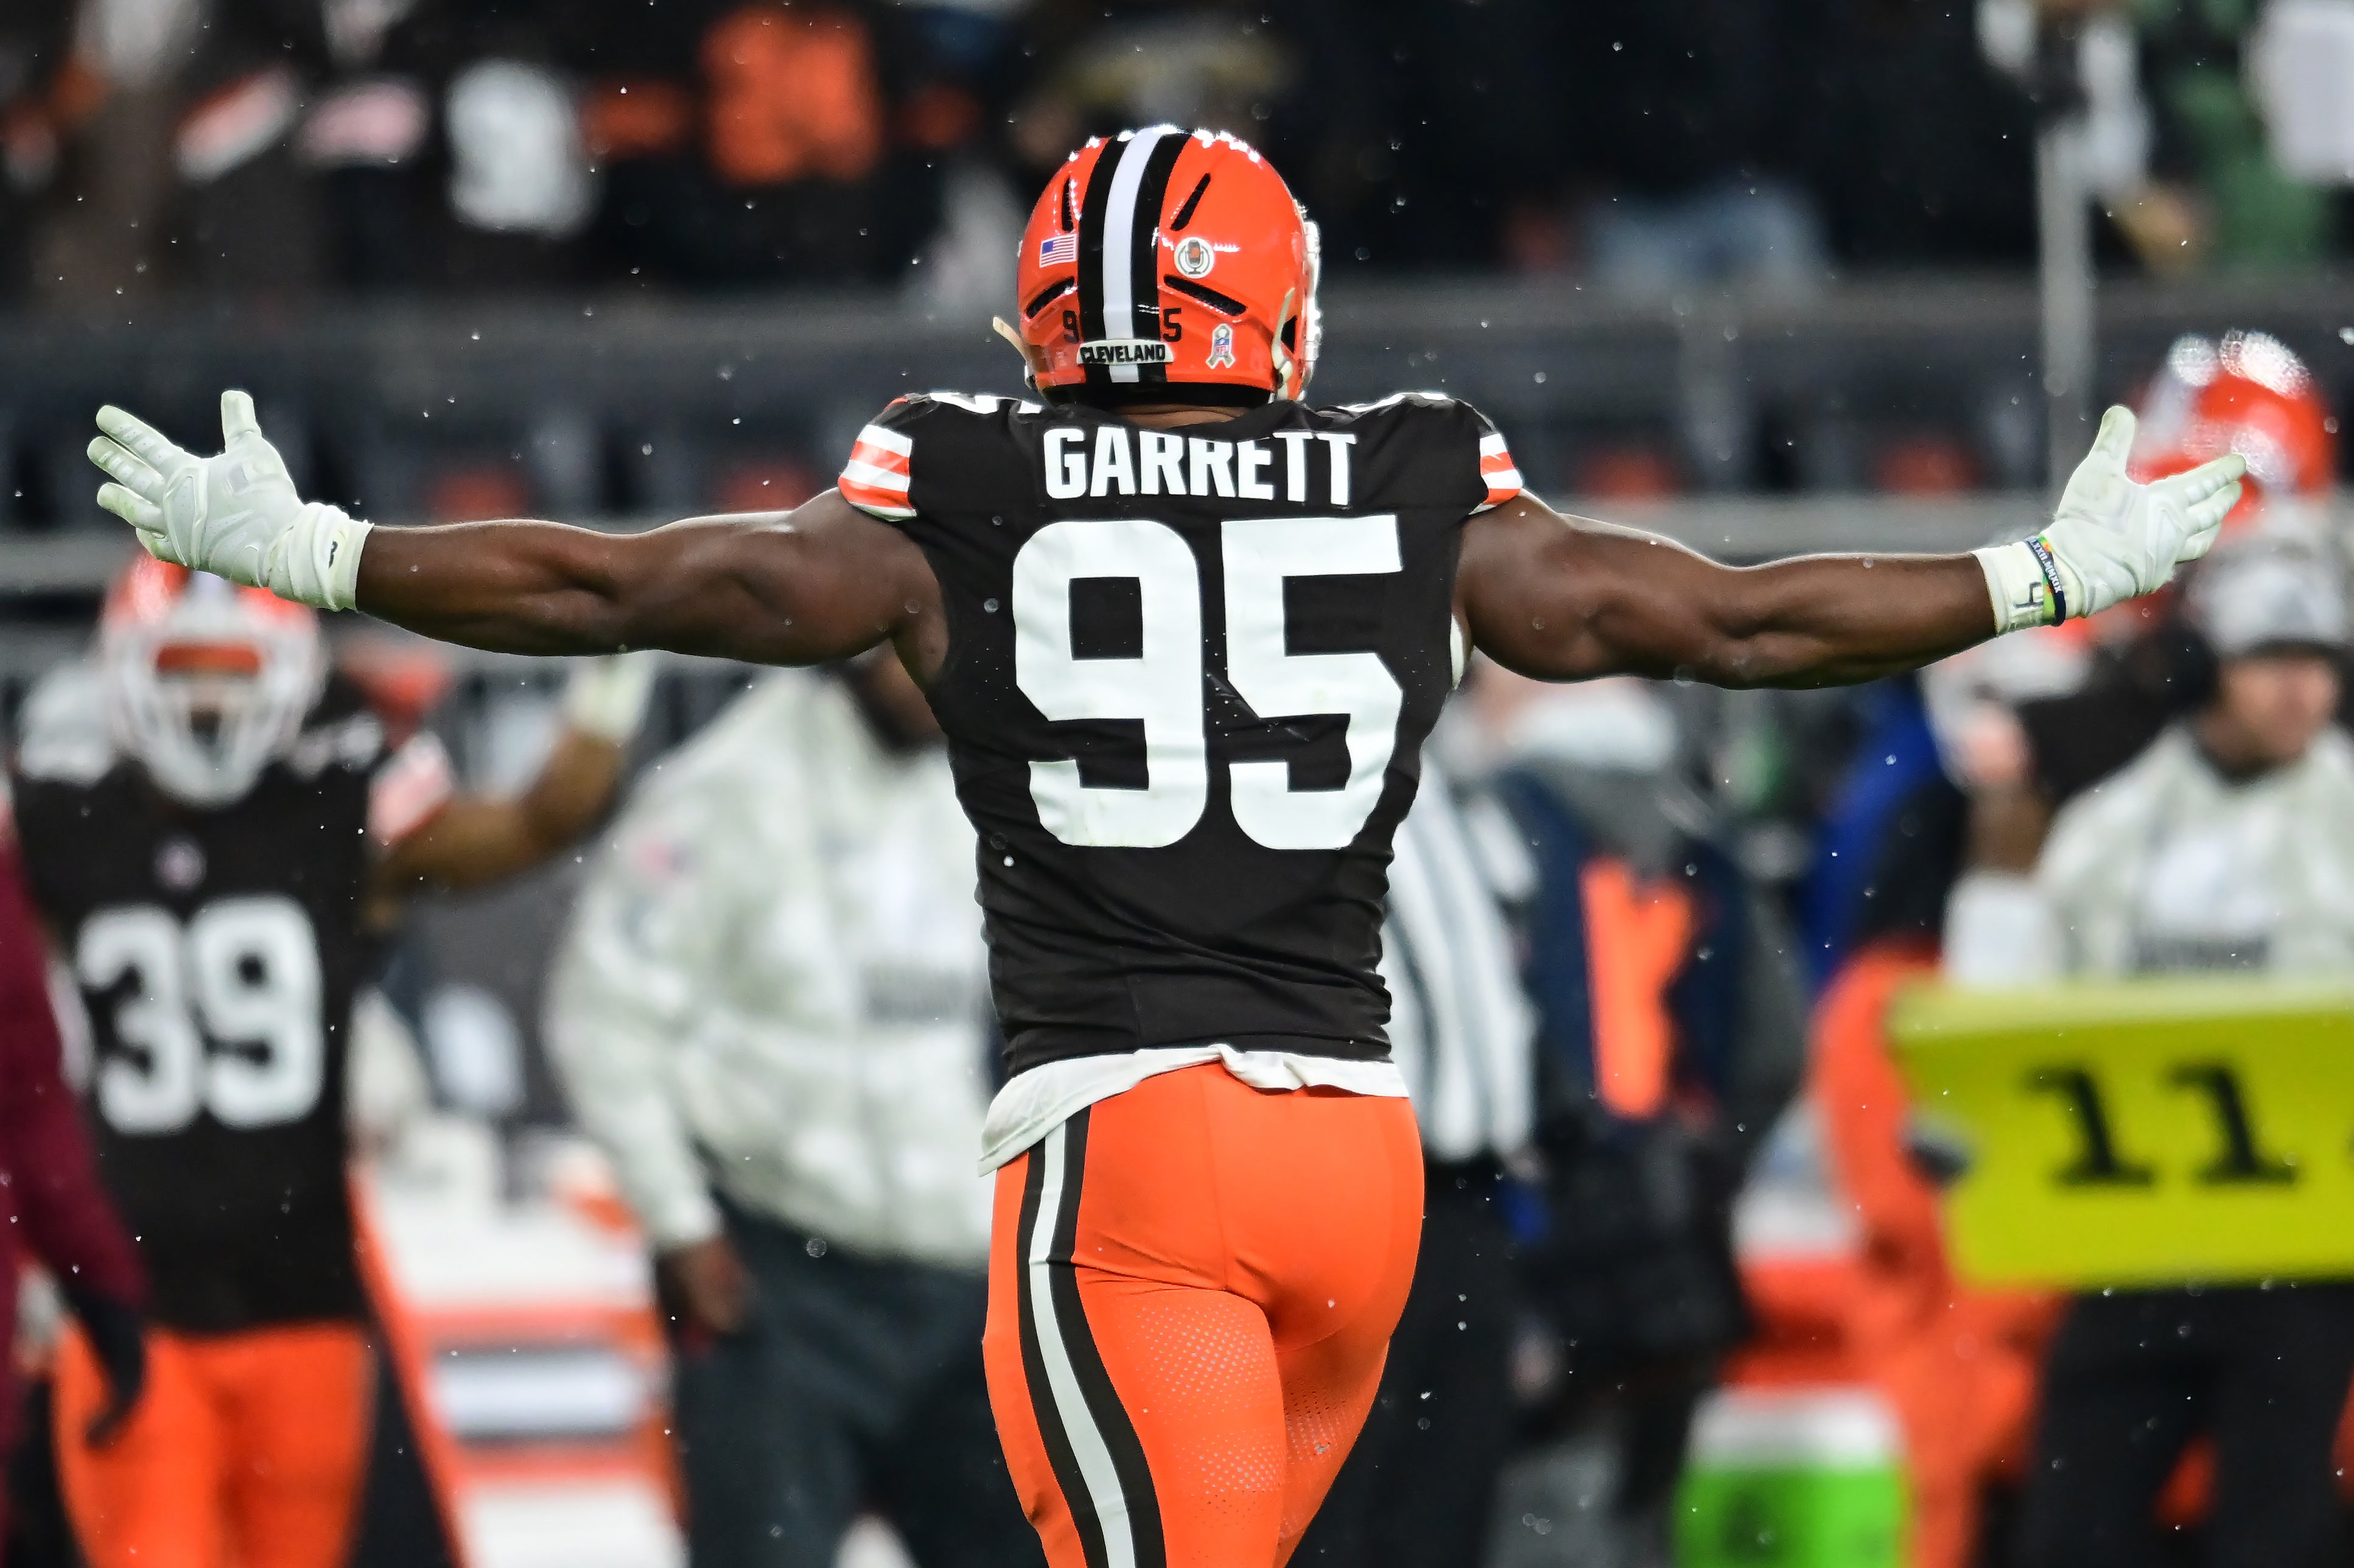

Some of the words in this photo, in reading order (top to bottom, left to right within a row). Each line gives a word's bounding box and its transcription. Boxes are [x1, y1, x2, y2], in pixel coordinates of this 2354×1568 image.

[1063, 310, 1079, 343] 9
[1163, 308, 1182, 342] 5
[1080, 344, 1165, 363] CLEVELAND
[1043, 427, 1357, 505] GARRETT
[1012, 514, 1404, 850] 95
[78, 897, 324, 1132] 39
[2021, 1060, 2300, 1188] 11
